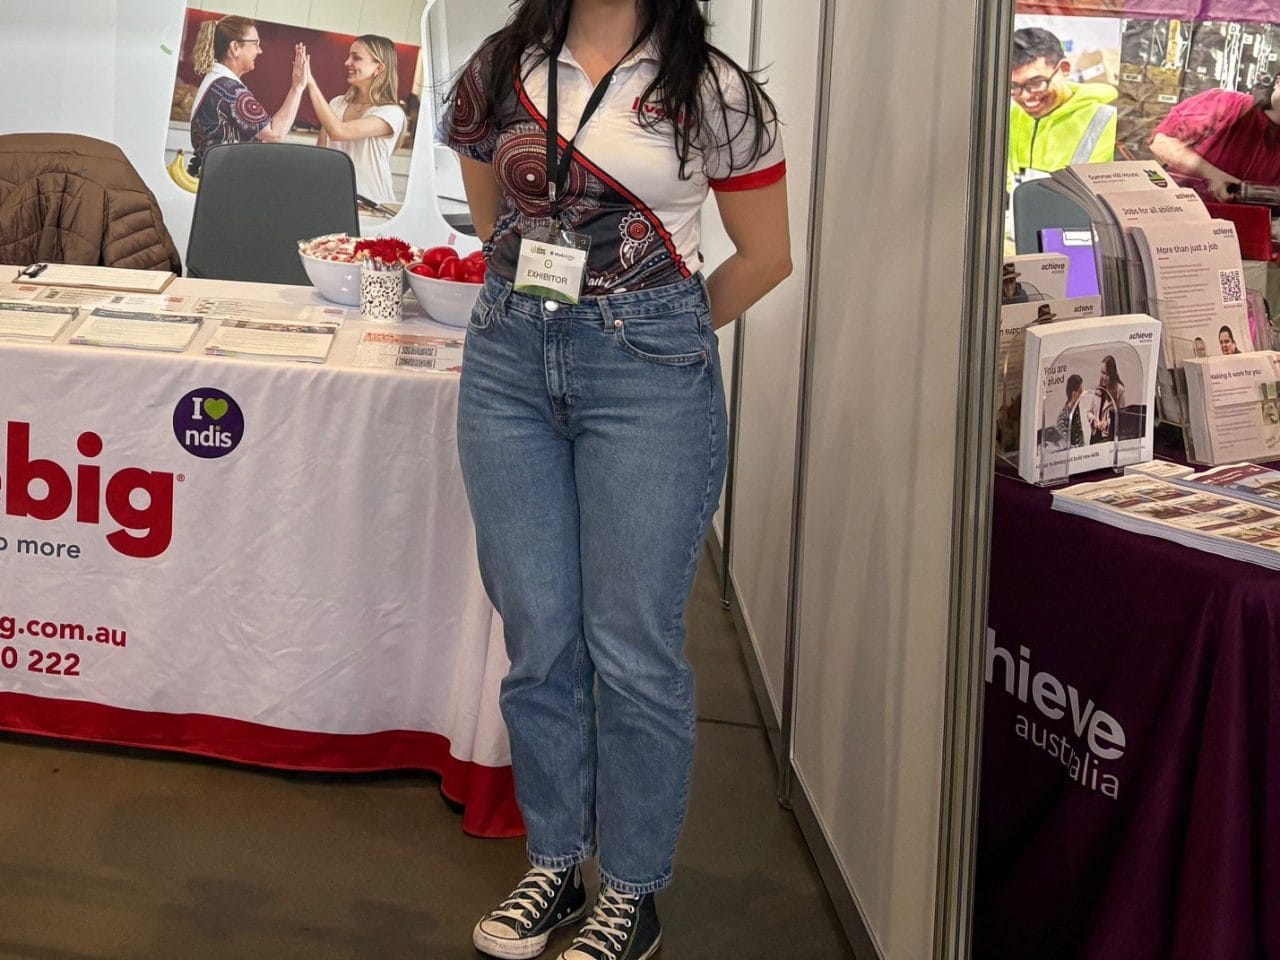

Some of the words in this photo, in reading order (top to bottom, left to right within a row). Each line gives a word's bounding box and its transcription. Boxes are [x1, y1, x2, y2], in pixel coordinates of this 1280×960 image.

[1156, 246, 1174, 254] More
[1174, 245, 1190, 253] than
[1190, 244, 1203, 253] just
[1208, 243, 1219, 252] job
[527, 269, 568, 286] EXHIBITOR
[1129, 331, 1153, 340] achieve
[1043, 366, 1056, 375] You
[192, 397, 202, 420] I
[185, 424, 232, 448] ndis
[17, 538, 81, 559] more
[27, 649, 80, 676] 222
[1015, 714, 1119, 800] australia
